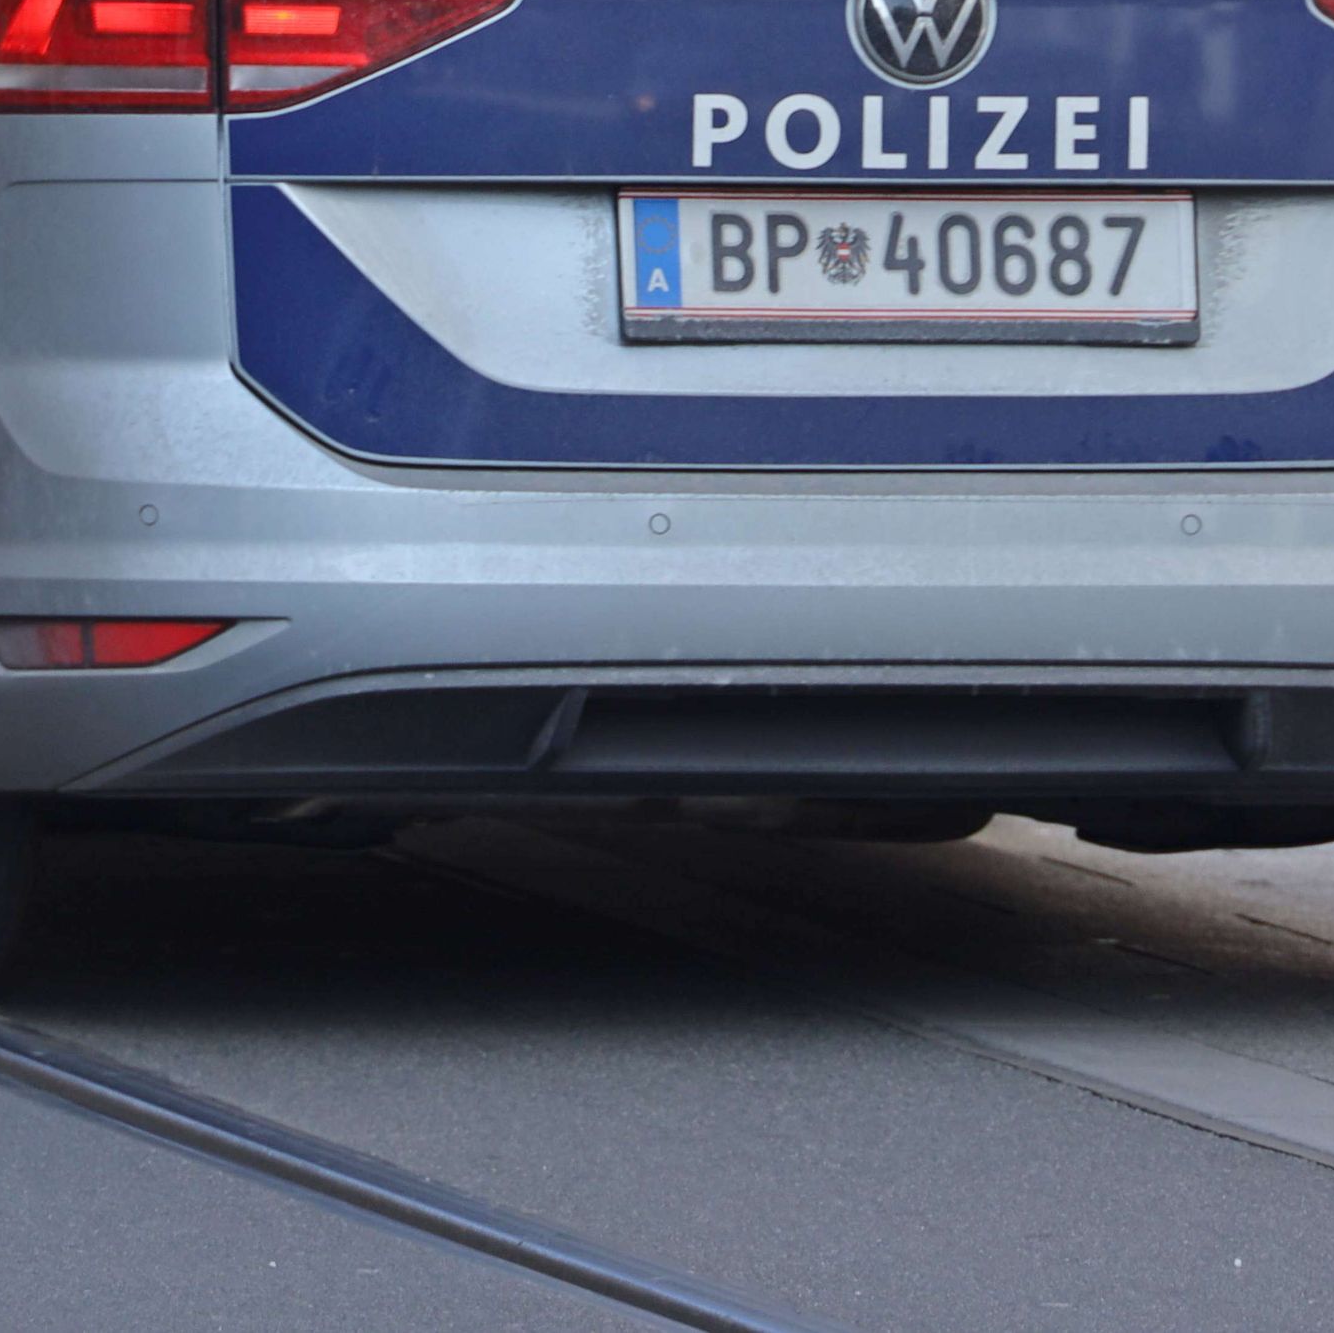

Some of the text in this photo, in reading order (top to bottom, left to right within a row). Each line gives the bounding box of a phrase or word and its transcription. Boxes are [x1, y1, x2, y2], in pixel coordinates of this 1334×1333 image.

[692, 93, 1149, 170] POLIZEI
[647, 269, 670, 293] A
[710, 211, 1146, 297] BP 40687
